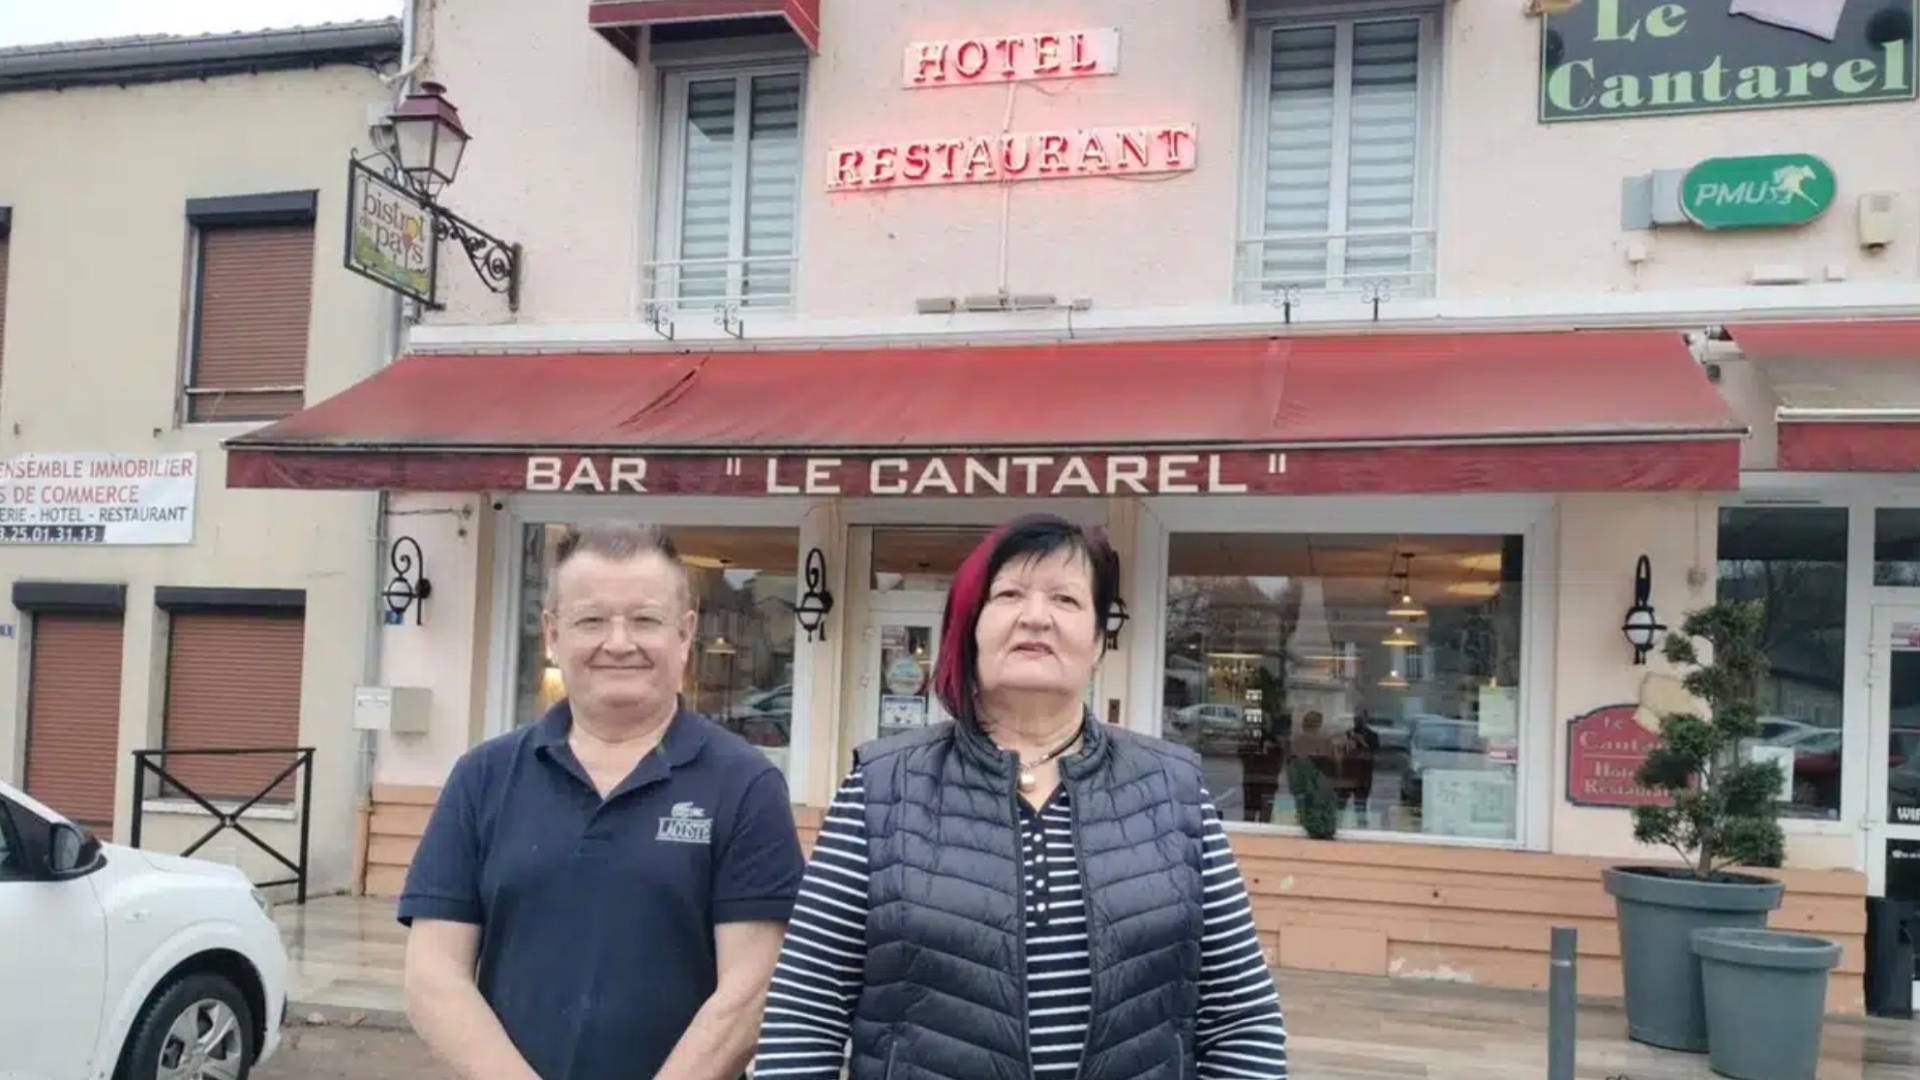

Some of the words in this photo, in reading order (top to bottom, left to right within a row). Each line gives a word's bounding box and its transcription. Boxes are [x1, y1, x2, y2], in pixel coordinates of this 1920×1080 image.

[1592, 0, 1688, 41] Le
[913, 34, 1098, 83] HOTEL
[1548, 38, 1909, 111] Cantarel
[831, 128, 1190, 188] RESTAURANT
[363, 180, 424, 242] bistrot
[1694, 181, 1770, 206] PMU
[374, 222, 423, 269] pays
[90, 459, 193, 478] IMMOBILIER
[526, 457, 648, 491] BAR
[767, 458, 842, 494] LE
[869, 454, 1248, 494] CANTAREL
[13, 486, 36, 503] DE
[41, 485, 140, 503] COMMERCE
[40, 507, 84, 522] HOTEL
[100, 506, 187, 522] RESTAURANT
[656, 818, 712, 841] LACOSTE
